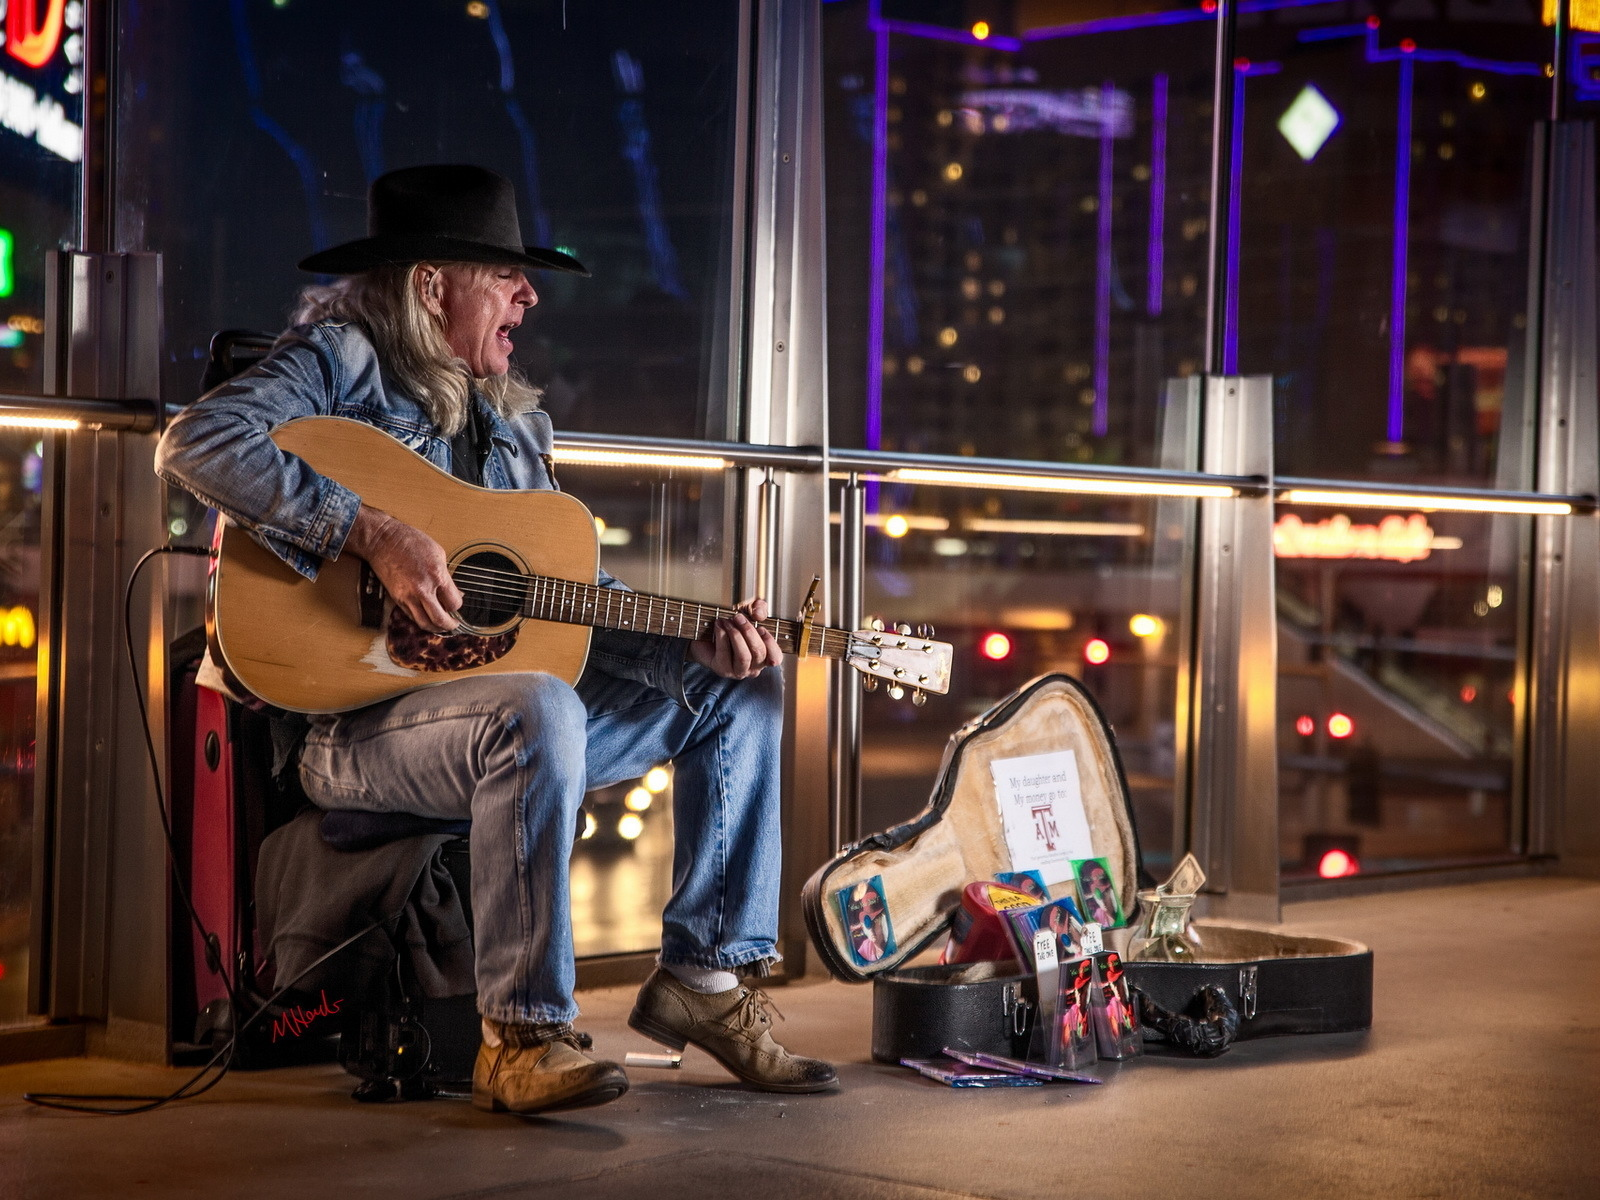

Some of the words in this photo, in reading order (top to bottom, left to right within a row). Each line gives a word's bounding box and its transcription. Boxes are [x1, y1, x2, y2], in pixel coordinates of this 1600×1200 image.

[1009, 777, 1021, 791] My
[1022, 774, 1051, 789] daughter
[1052, 770, 1067, 783] and
[1014, 793, 1024, 807] My
[1025, 793, 1048, 804] money
[1048, 792, 1056, 804] go
